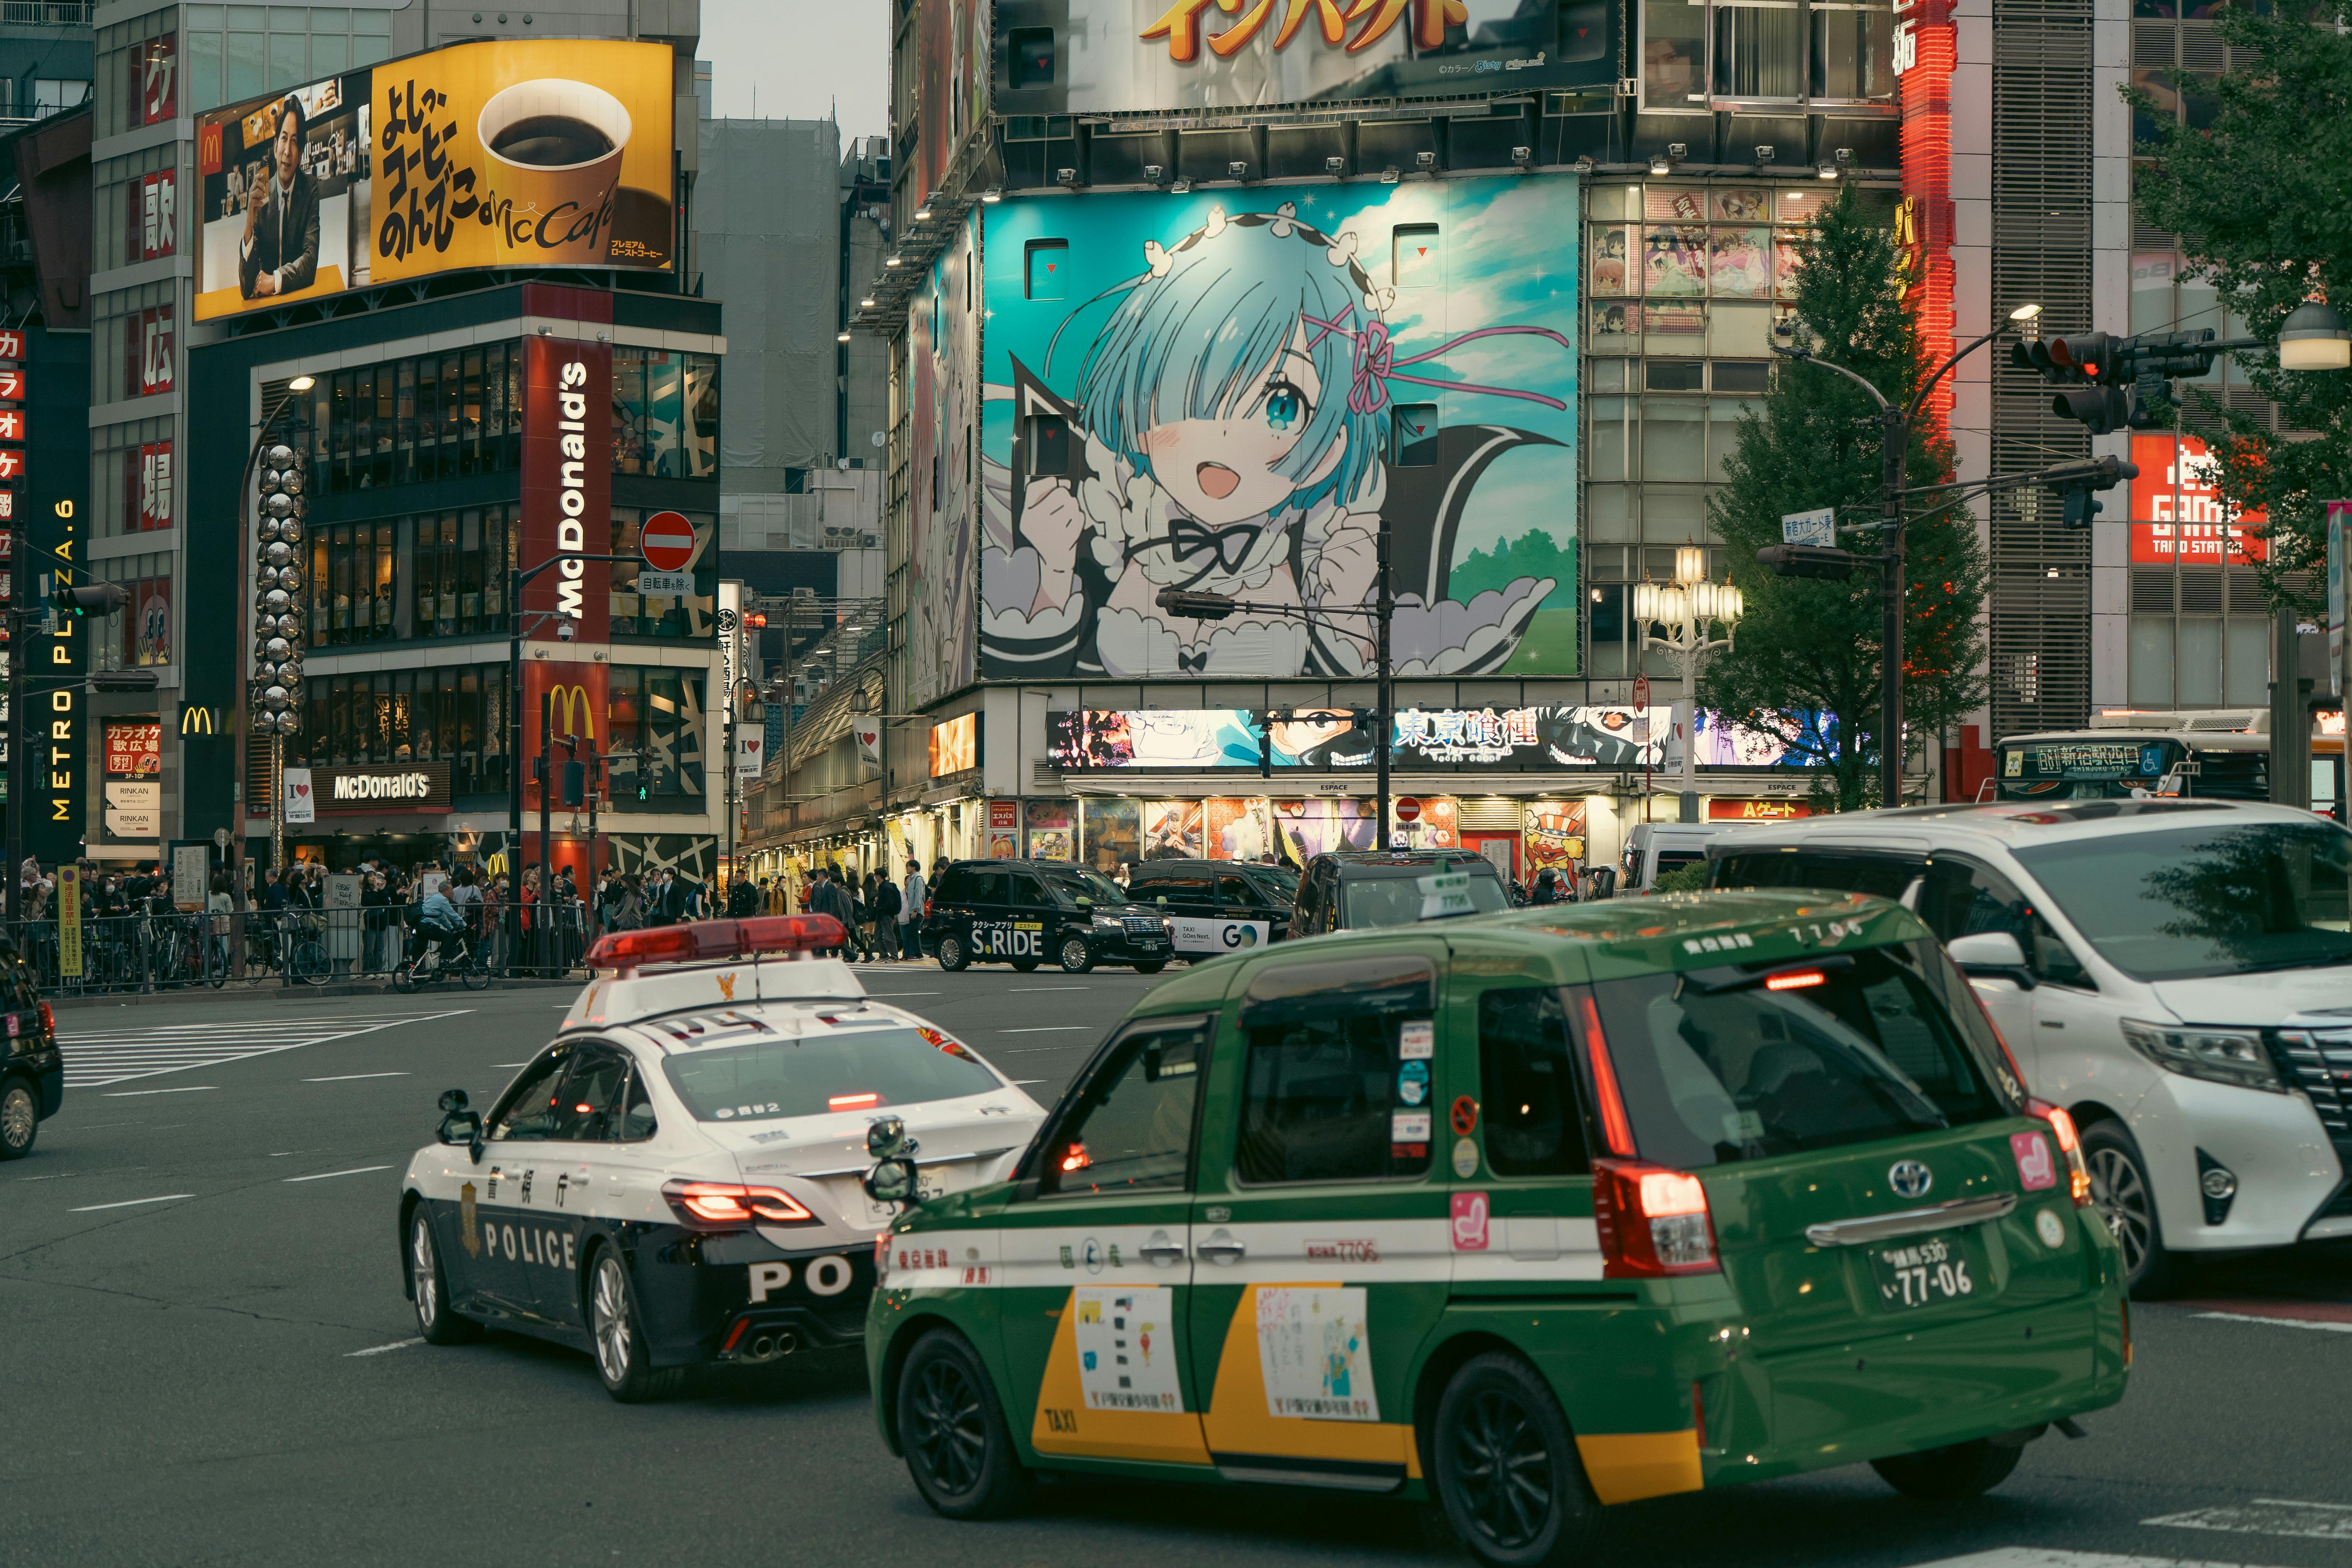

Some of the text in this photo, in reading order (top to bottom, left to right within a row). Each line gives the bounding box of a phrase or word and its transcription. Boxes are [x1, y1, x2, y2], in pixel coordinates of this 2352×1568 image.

[1475, 60, 1502, 73] Bisty
[611, 240, 645, 249] プレミアム
[611, 249, 663, 258] ローストコーヒー
[557, 361, 587, 620] McDonald's
[1785, 514, 1832, 537] 新宿大ガード東
[2152, 495, 2242, 537] GAME
[1824, 533, 1829, 542] E
[2152, 540, 2188, 553] TAIO
[643, 576, 690, 592] 自転車を除く
[52, 500, 73, 820] METRO PLZA.6
[1636, 689, 1646, 702] 消火栓
[108, 726, 161, 740] カラオケ
[1396, 708, 1539, 745] 東京喰種
[113, 740, 159, 752] 歌広場
[740, 740, 746, 754] I
[288, 784, 296, 799] I
[334, 772, 430, 800] McDonald's
[1742, 801, 1796, 818] Aゲート
[64, 884, 75, 925] 違法駐車禁止
[972, 921, 1012, 930] タクシーアプリ
[1788, 922, 1863, 942] 7706
[972, 929, 1043, 956] S.RIDE
[1222, 924, 1258, 948] GO
[487, 1165, 569, 1208] 警視庁
[484, 1222, 577, 1270] POLICE
[1338, 1241, 1378, 1262] 7706
[1895, 1259, 1973, 1305] 77-06
[1044, 1408, 1078, 1434] TAXI
